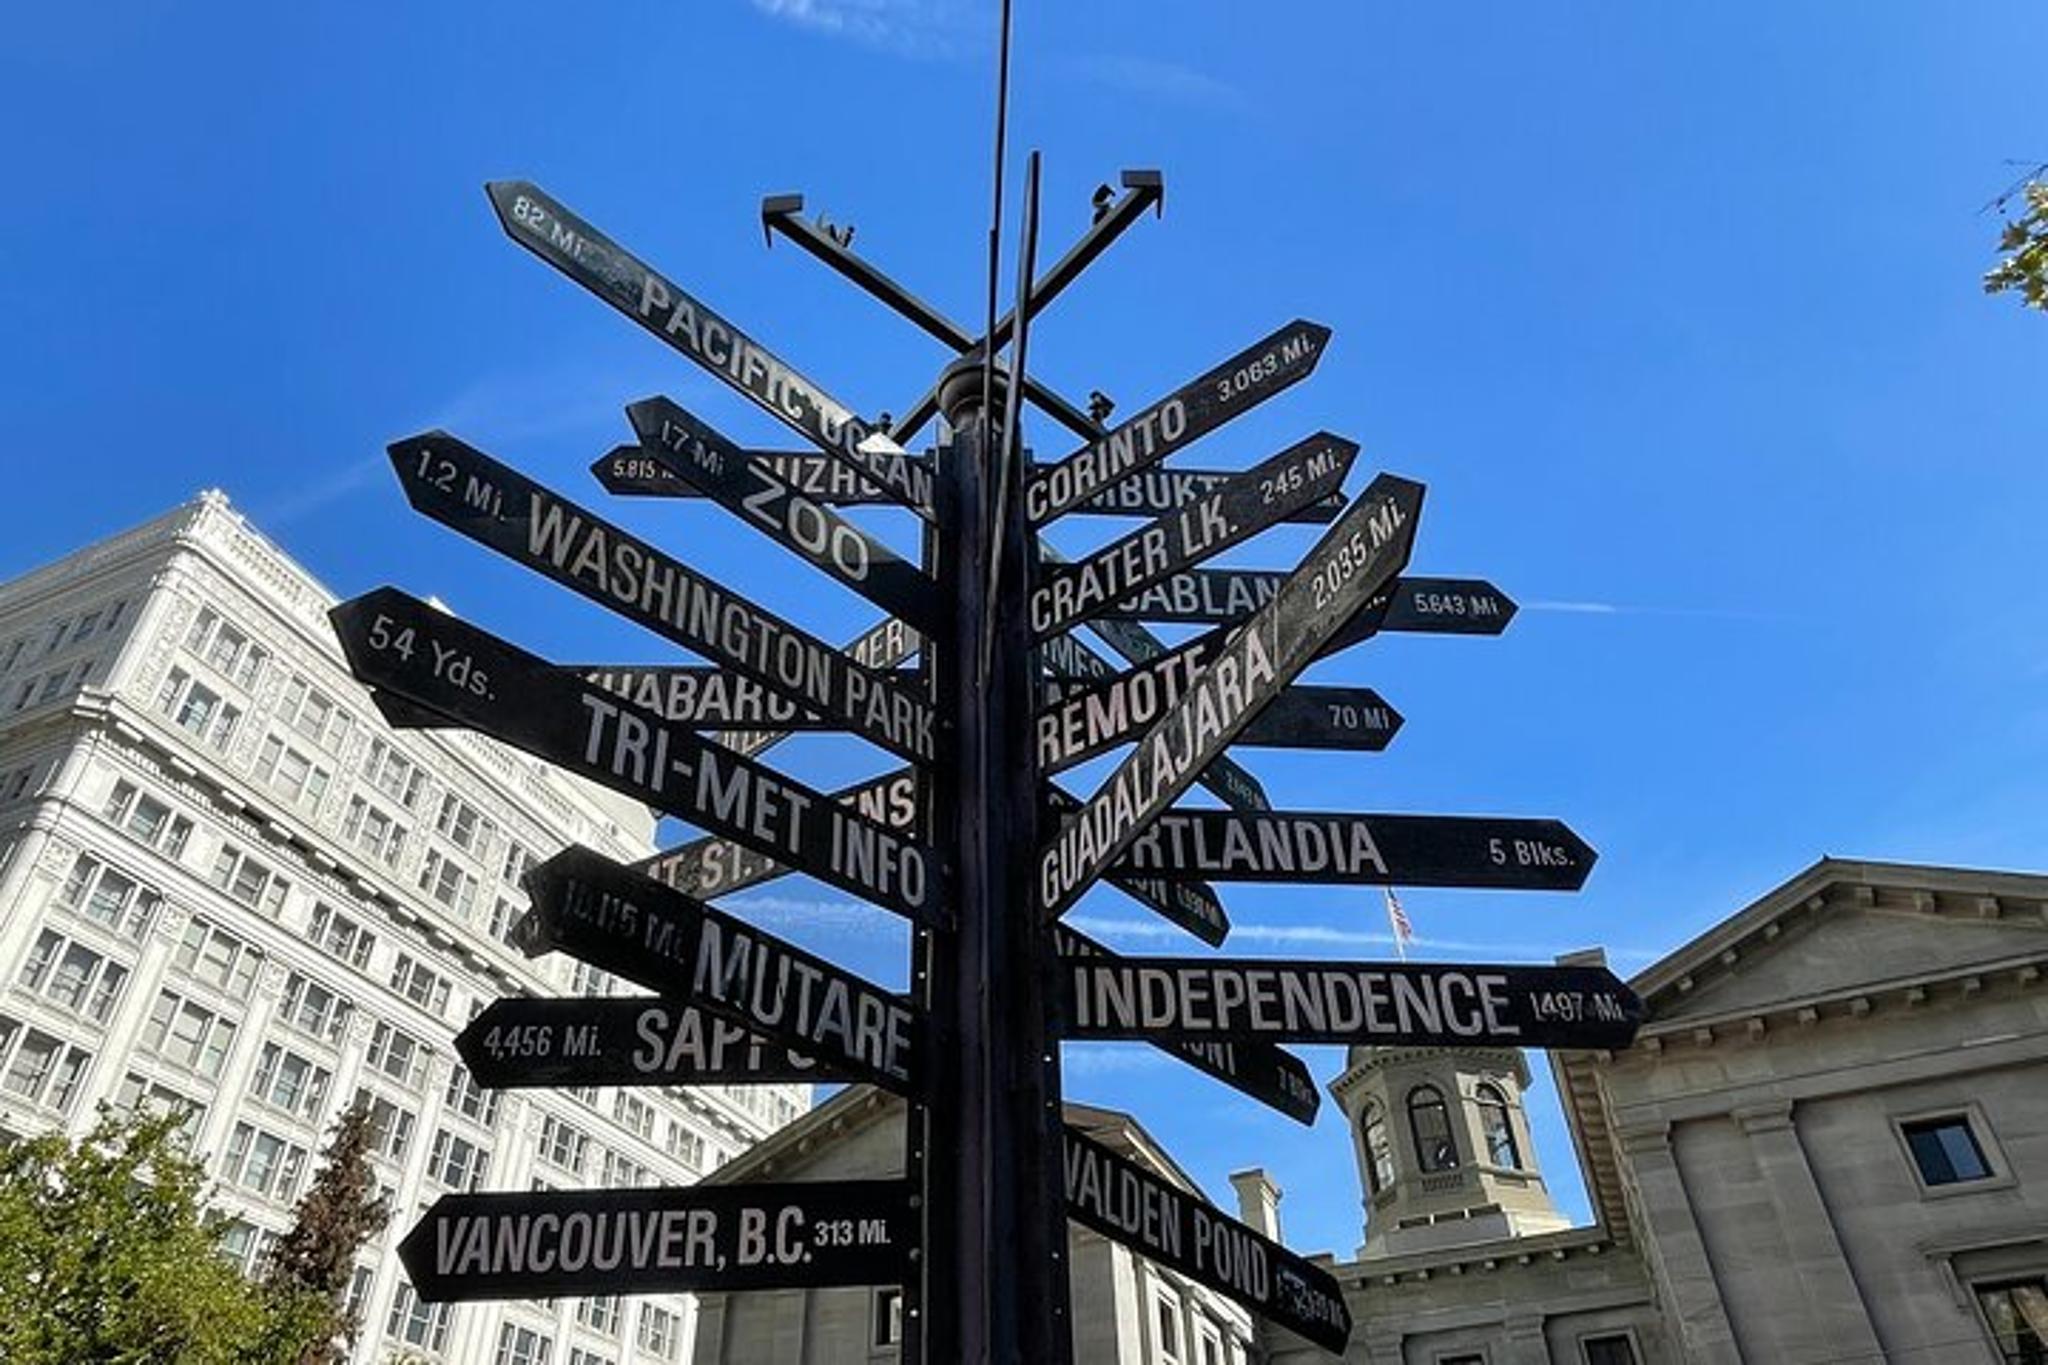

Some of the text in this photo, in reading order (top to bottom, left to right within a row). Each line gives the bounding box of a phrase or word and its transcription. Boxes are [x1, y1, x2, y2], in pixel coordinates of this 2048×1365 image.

[512, 195, 545, 230] 82
[639, 272, 804, 419] PACIFIC
[413, 450, 506, 522] 1.2 Mi.
[1027, 398, 1187, 522] CORINTO
[1259, 475, 1302, 505] 245
[1306, 448, 1342, 482] Mi.
[742, 462, 869, 583] ZOO
[1031, 494, 1239, 633] CRATER LK.
[1368, 497, 1406, 547] Mi.
[368, 613, 498, 701] 54 Yds.
[526, 493, 935, 761] WASHINGTON PARK
[1036, 645, 1209, 769] REMOTE
[1327, 704, 1358, 729] 70
[582, 692, 926, 907] TRI-MET INFO
[1041, 626, 1275, 909] GUADALAJARA
[1113, 814, 1577, 875] RTLANDIA 5 Blks.
[562, 1025, 602, 1056] Mi.
[694, 914, 913, 1084] MUTARE
[1074, 966, 1520, 1037] INDEPENDENCE
[434, 1205, 892, 1276] VANCOUVER, B.C. 313 Mi.
[1193, 1206, 1270, 1302] POND
